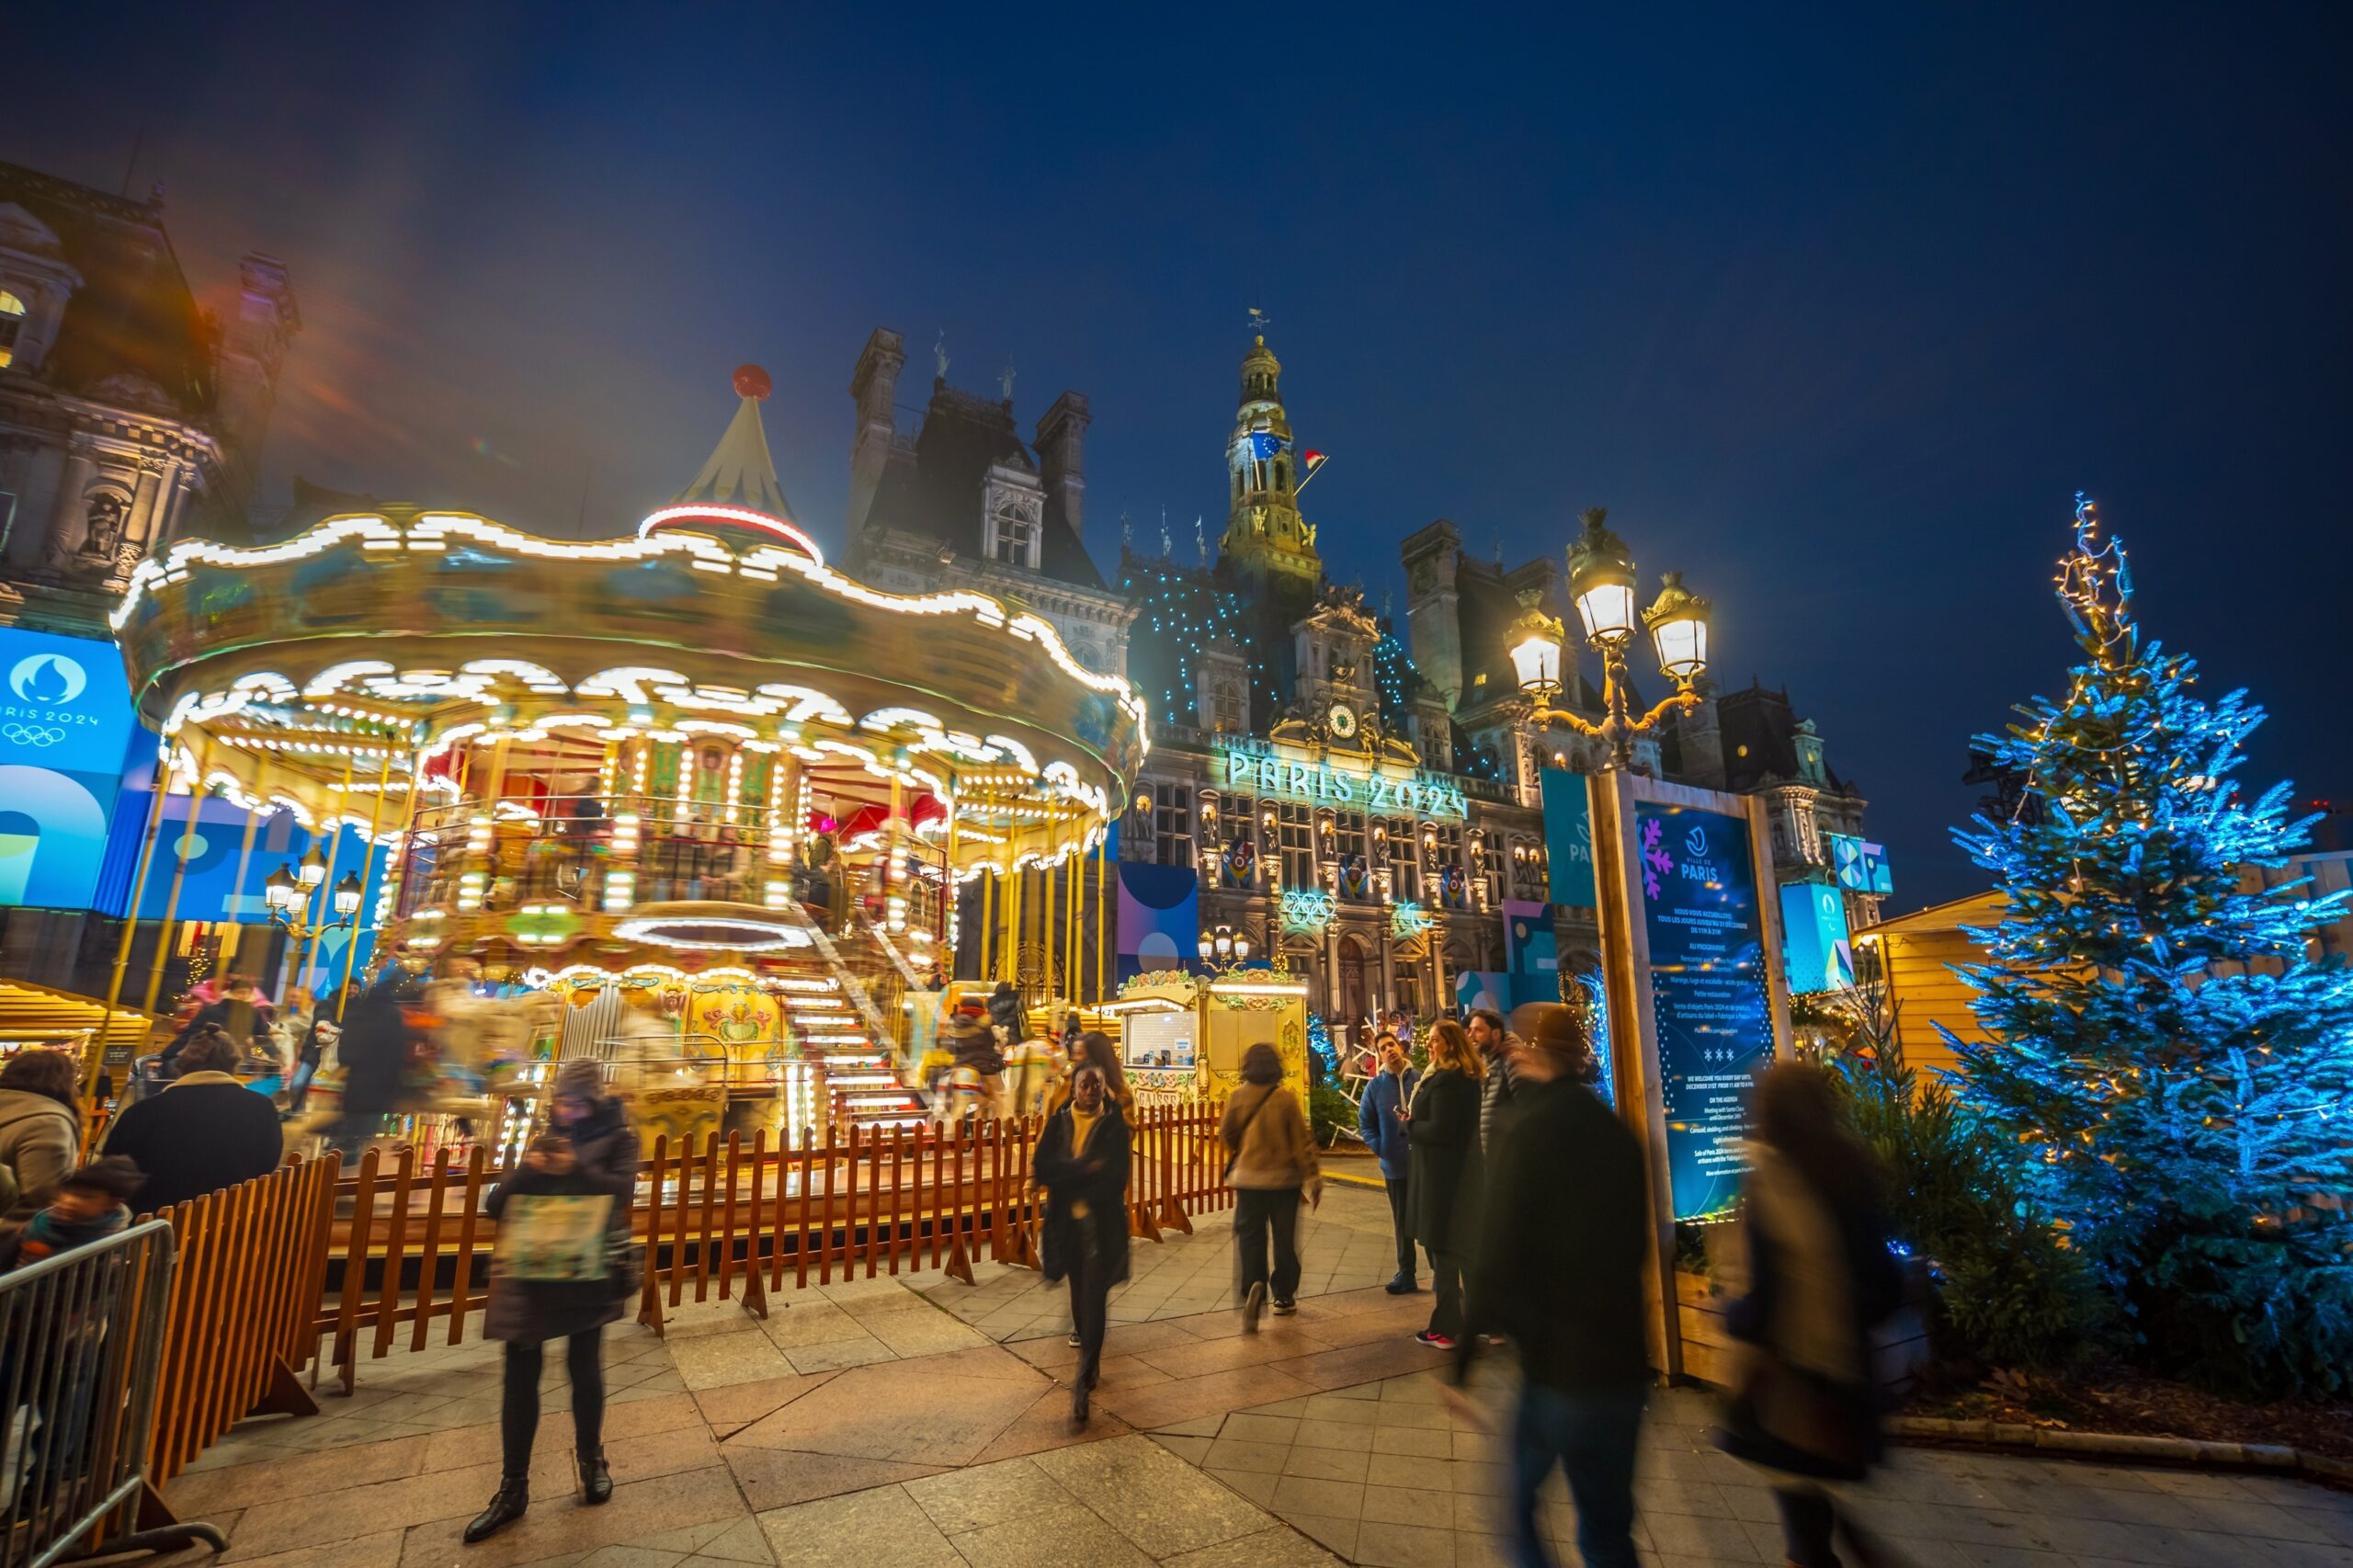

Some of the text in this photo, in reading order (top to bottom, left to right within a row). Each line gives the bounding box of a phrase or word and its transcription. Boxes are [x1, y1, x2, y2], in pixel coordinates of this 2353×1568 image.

[0, 706, 98, 725] RIS 2024
[1229, 751, 1469, 820] PARIS 2024
[1569, 843, 1592, 863] PA
[1681, 863, 1718, 882] PARIS
[1657, 915, 1671, 923] TOUS
[1688, 909, 1702, 917] VOUS
